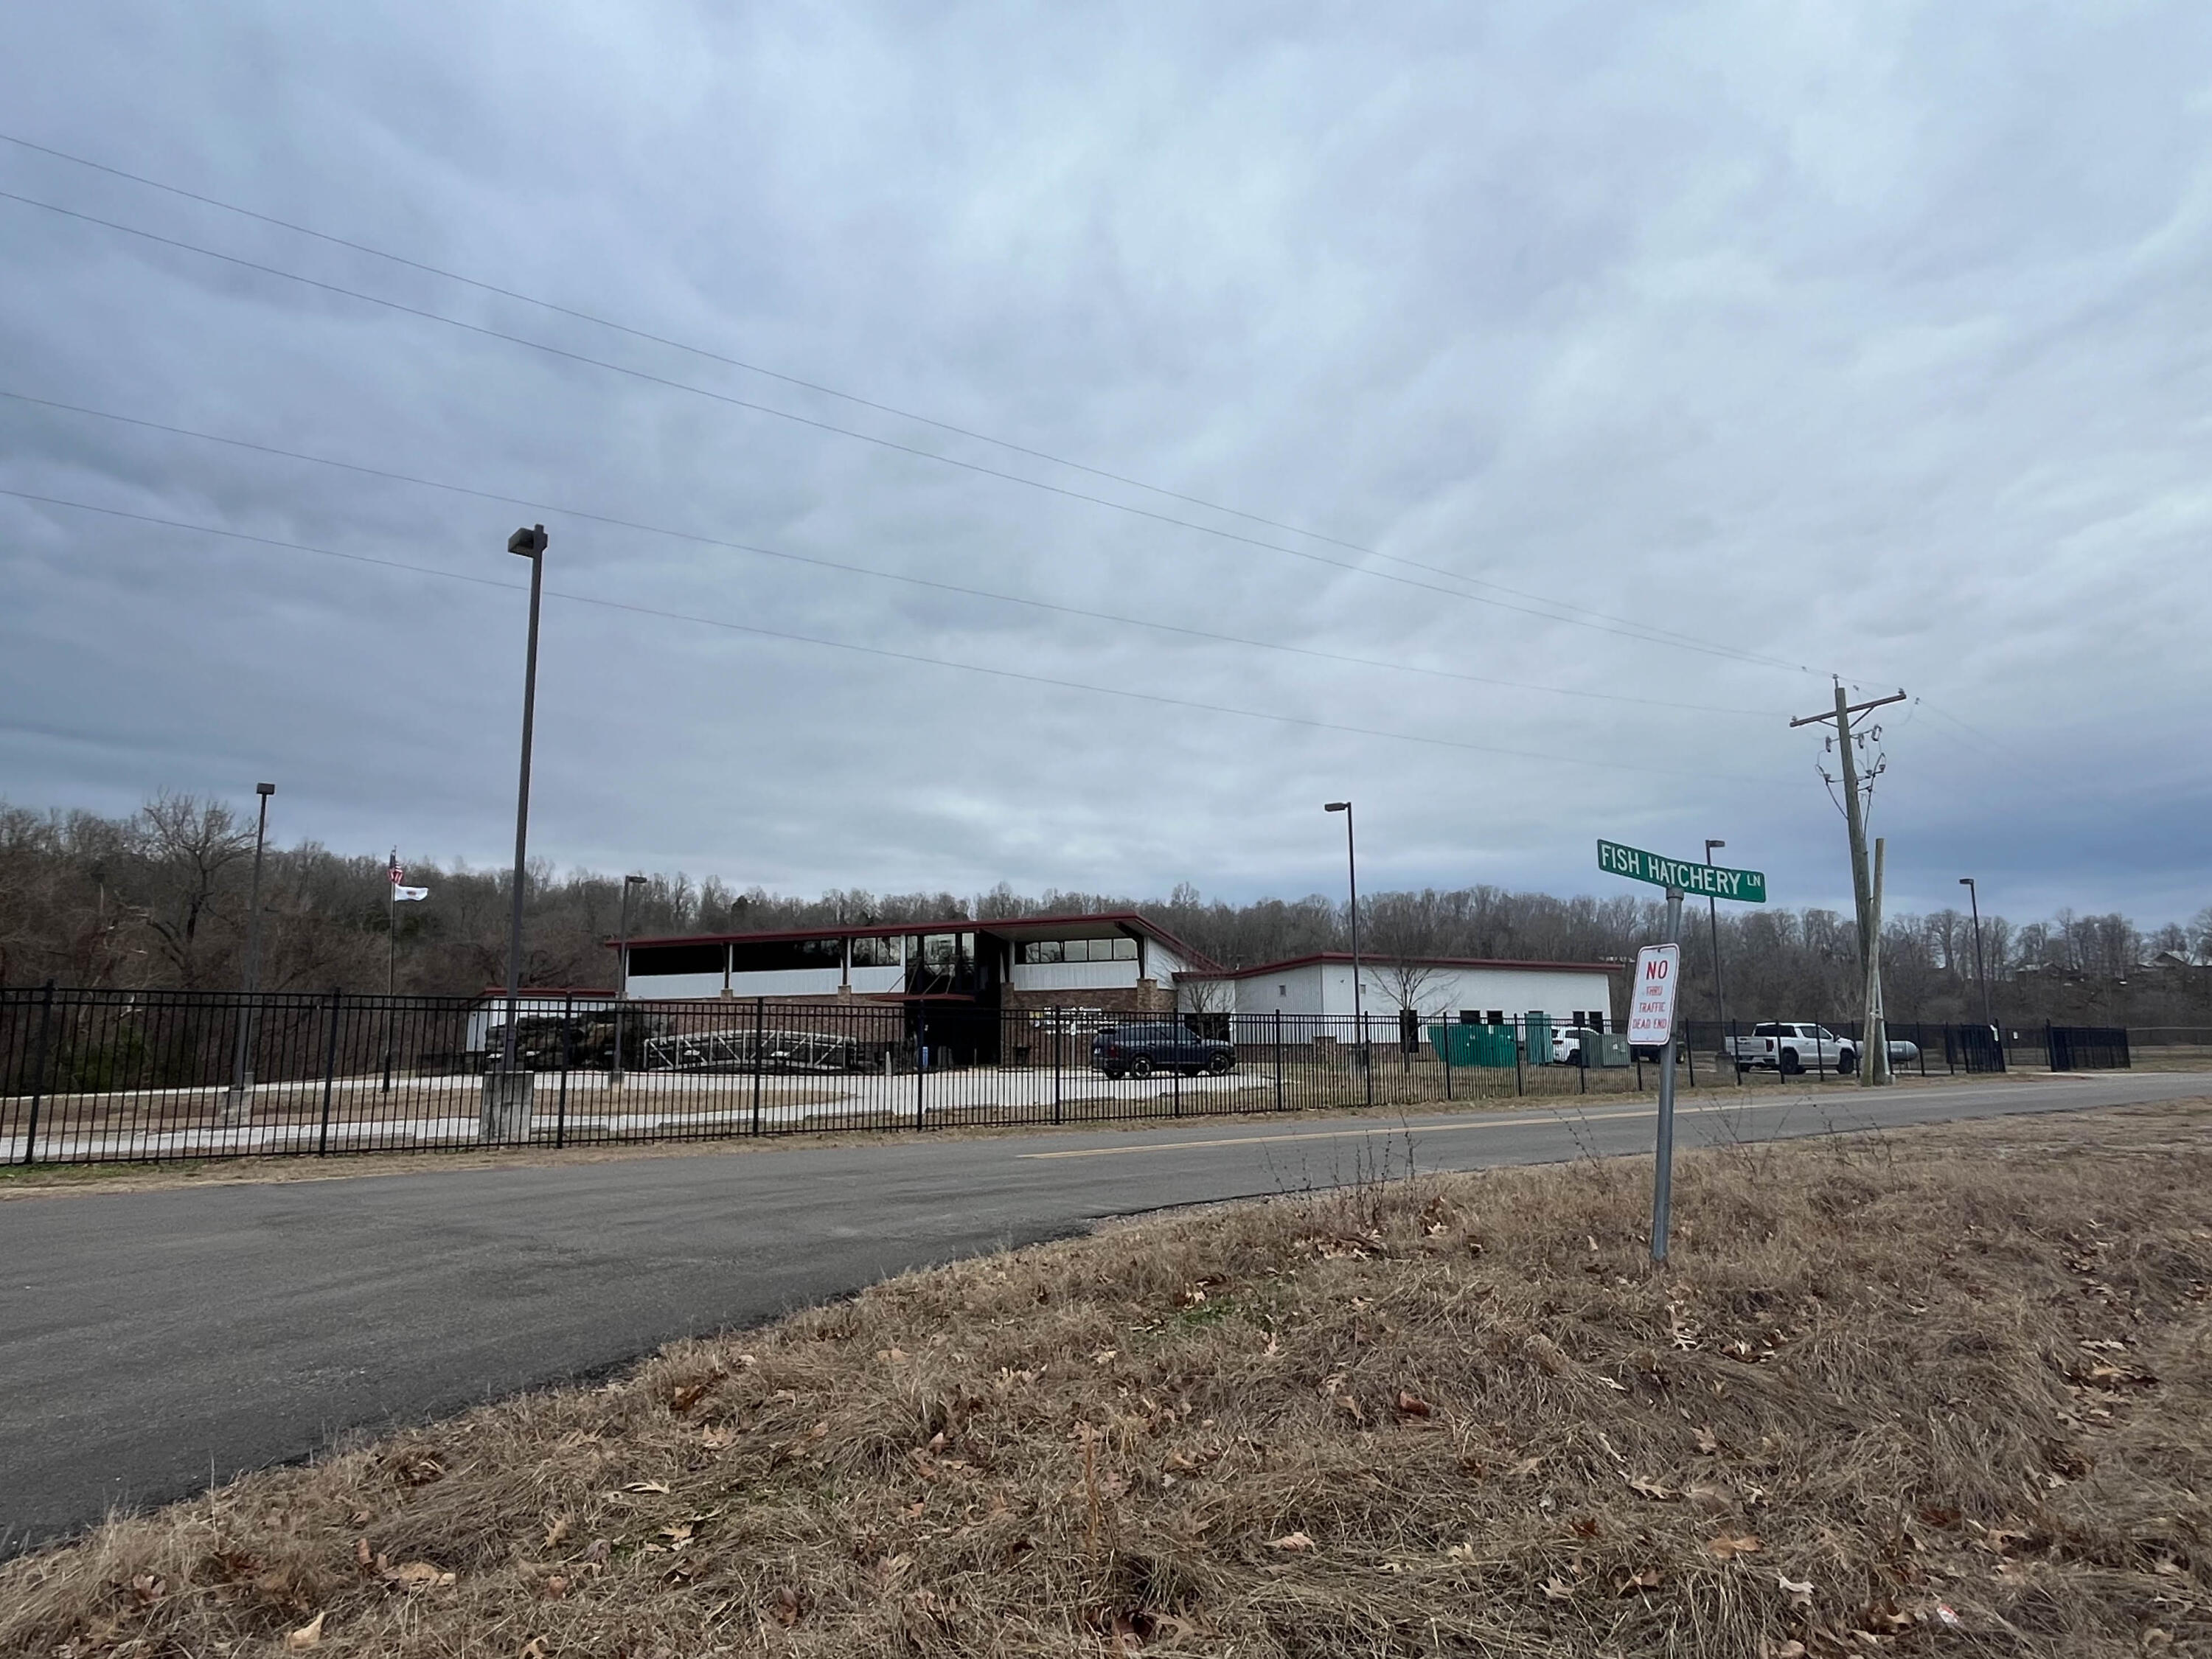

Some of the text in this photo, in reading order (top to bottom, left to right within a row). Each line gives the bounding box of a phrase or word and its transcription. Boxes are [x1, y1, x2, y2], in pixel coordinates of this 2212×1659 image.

[1601, 844, 1761, 895] FISH HATCHERY LN
[1646, 960, 1668, 980] NO
[1646, 985, 1663, 995] THRU
[1639, 1001, 1666, 1013] TRAFFIC
[1632, 1018, 1667, 1029] DEAD END
